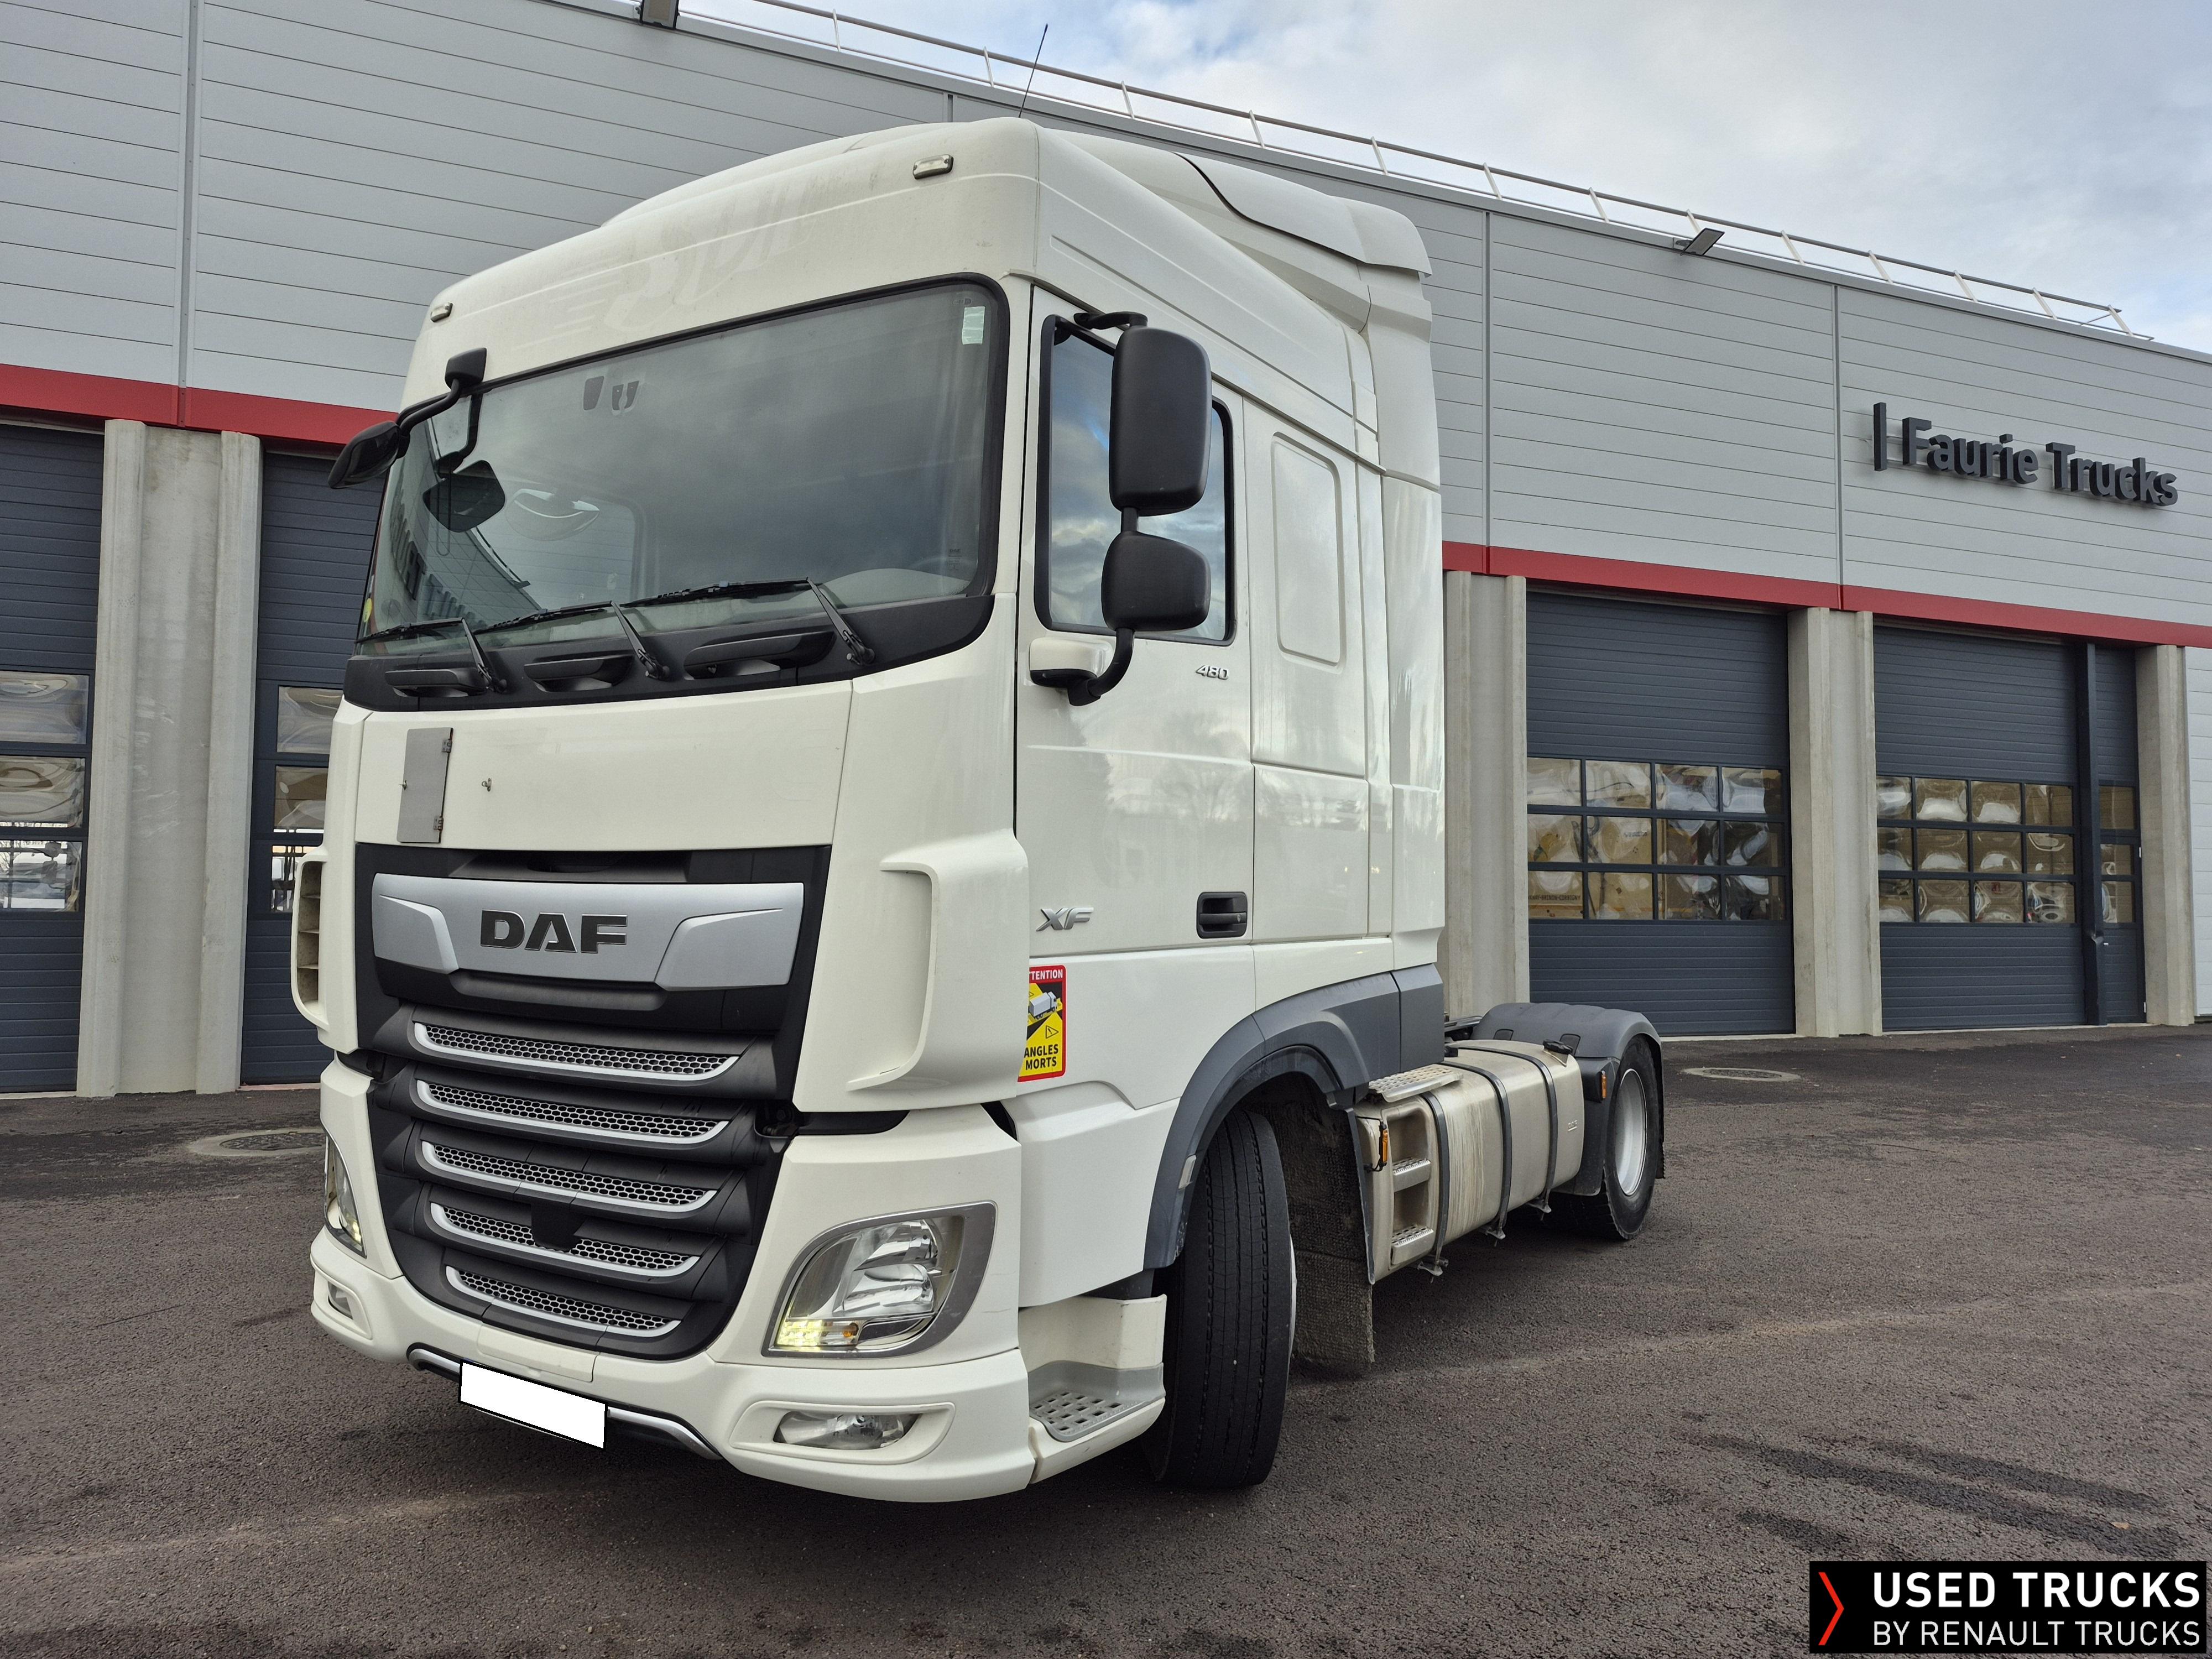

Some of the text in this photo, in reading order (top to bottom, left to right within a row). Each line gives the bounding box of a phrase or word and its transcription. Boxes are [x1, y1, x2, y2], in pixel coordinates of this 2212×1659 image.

[1902, 417, 2178, 506] Faurie Trucks
[1196, 665, 1229, 680] 480
[1036, 907, 1094, 932] XF
[480, 909, 628, 954] DAF
[1029, 969, 1063, 980] TENTION
[1024, 1044, 1058, 1058] ANGLES
[1026, 1057, 1057, 1070] MORTS
